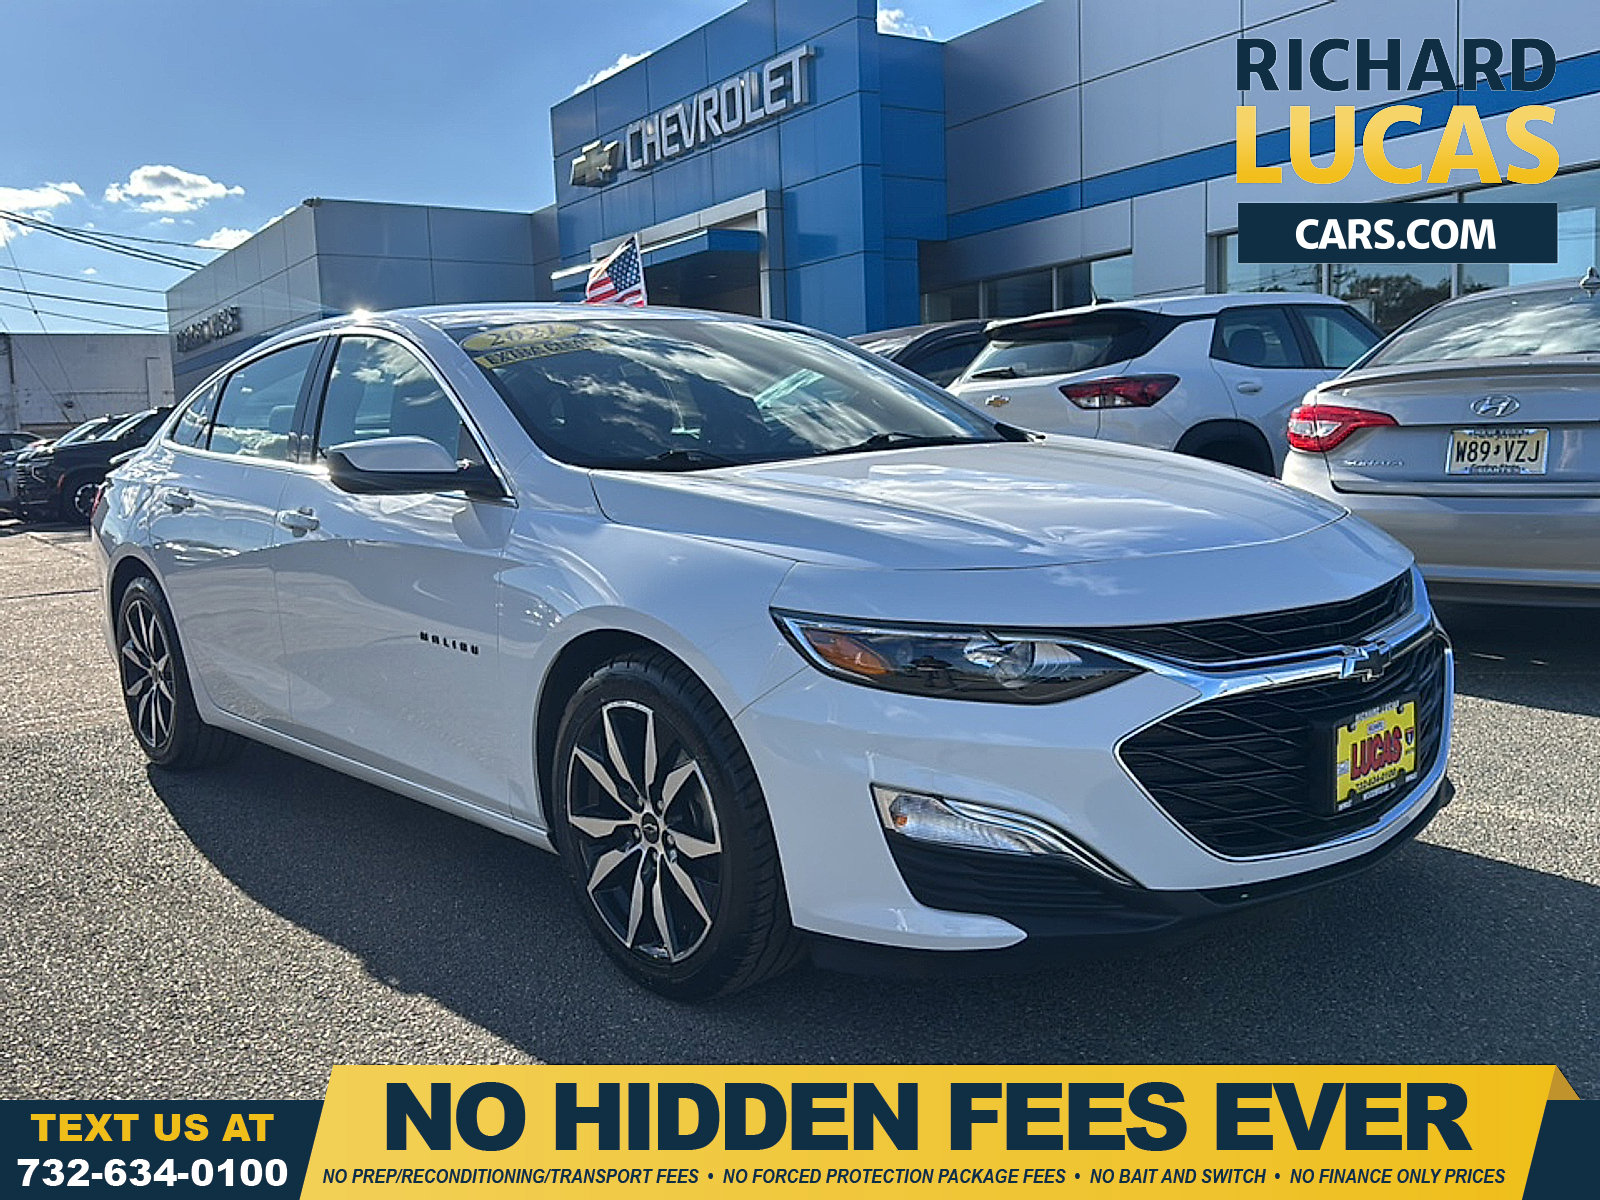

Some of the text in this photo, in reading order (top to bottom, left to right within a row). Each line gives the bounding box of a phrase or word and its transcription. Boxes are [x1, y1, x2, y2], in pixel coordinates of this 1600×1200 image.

[625, 44, 816, 171] CHEVROLET
[420, 631, 479, 655] MALIBU
[1350, 725, 1403, 781] LUCAS
